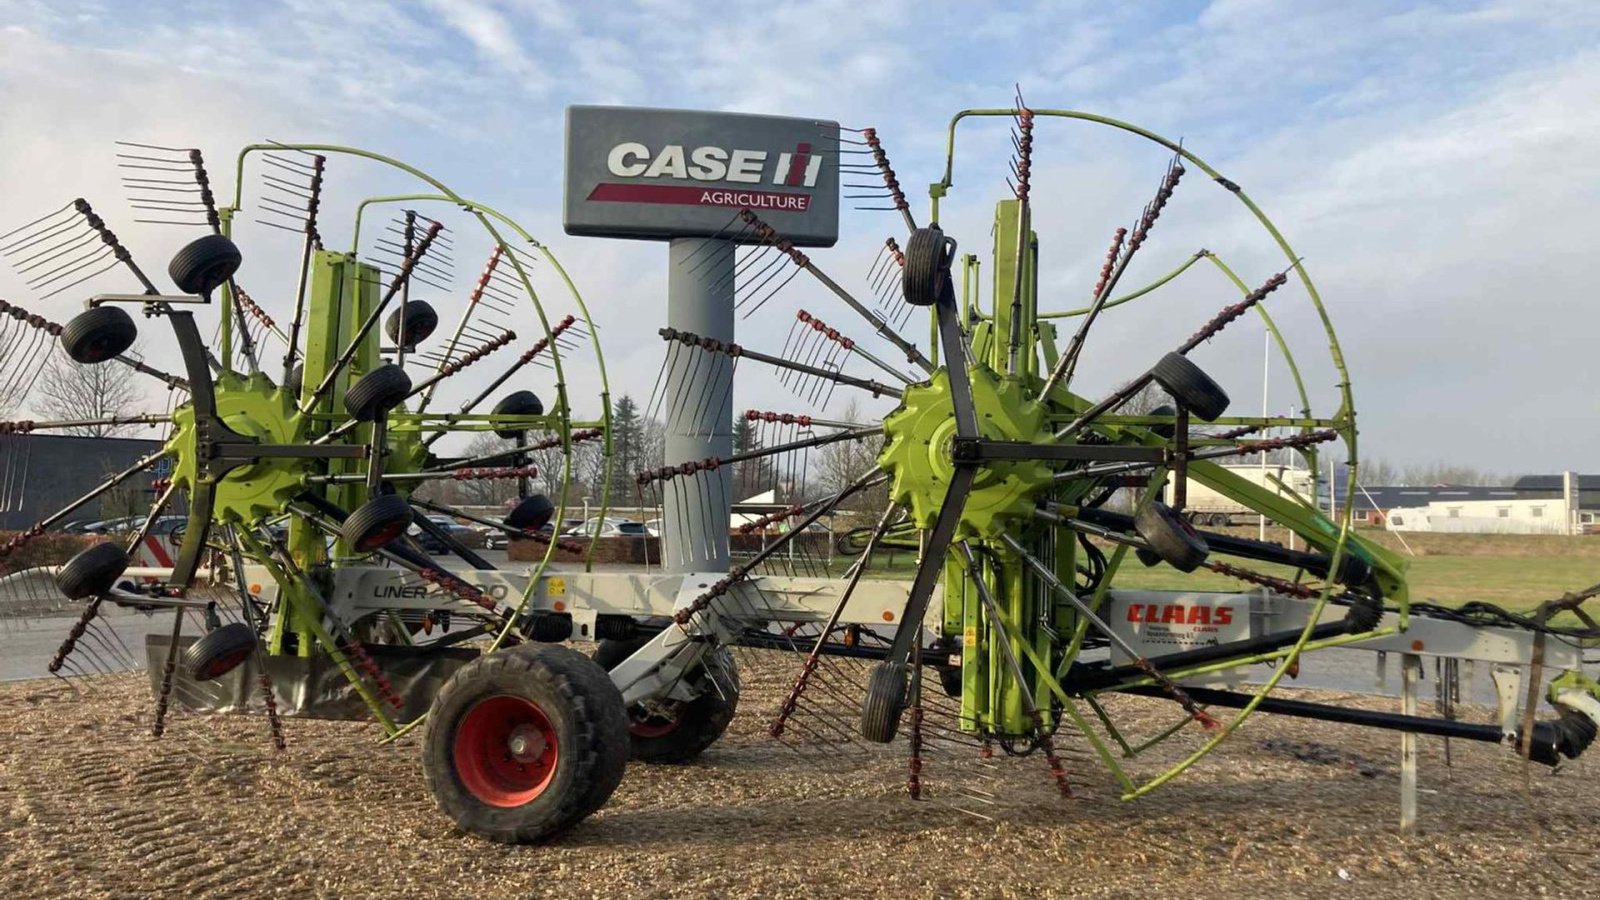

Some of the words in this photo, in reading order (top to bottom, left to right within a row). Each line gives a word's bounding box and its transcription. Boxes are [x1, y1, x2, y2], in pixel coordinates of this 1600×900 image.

[607, 142, 767, 183] CASE
[700, 191, 806, 210] AGRICULTURE
[374, 585, 427, 599] LINER
[1126, 603, 1234, 625] CLAAS
